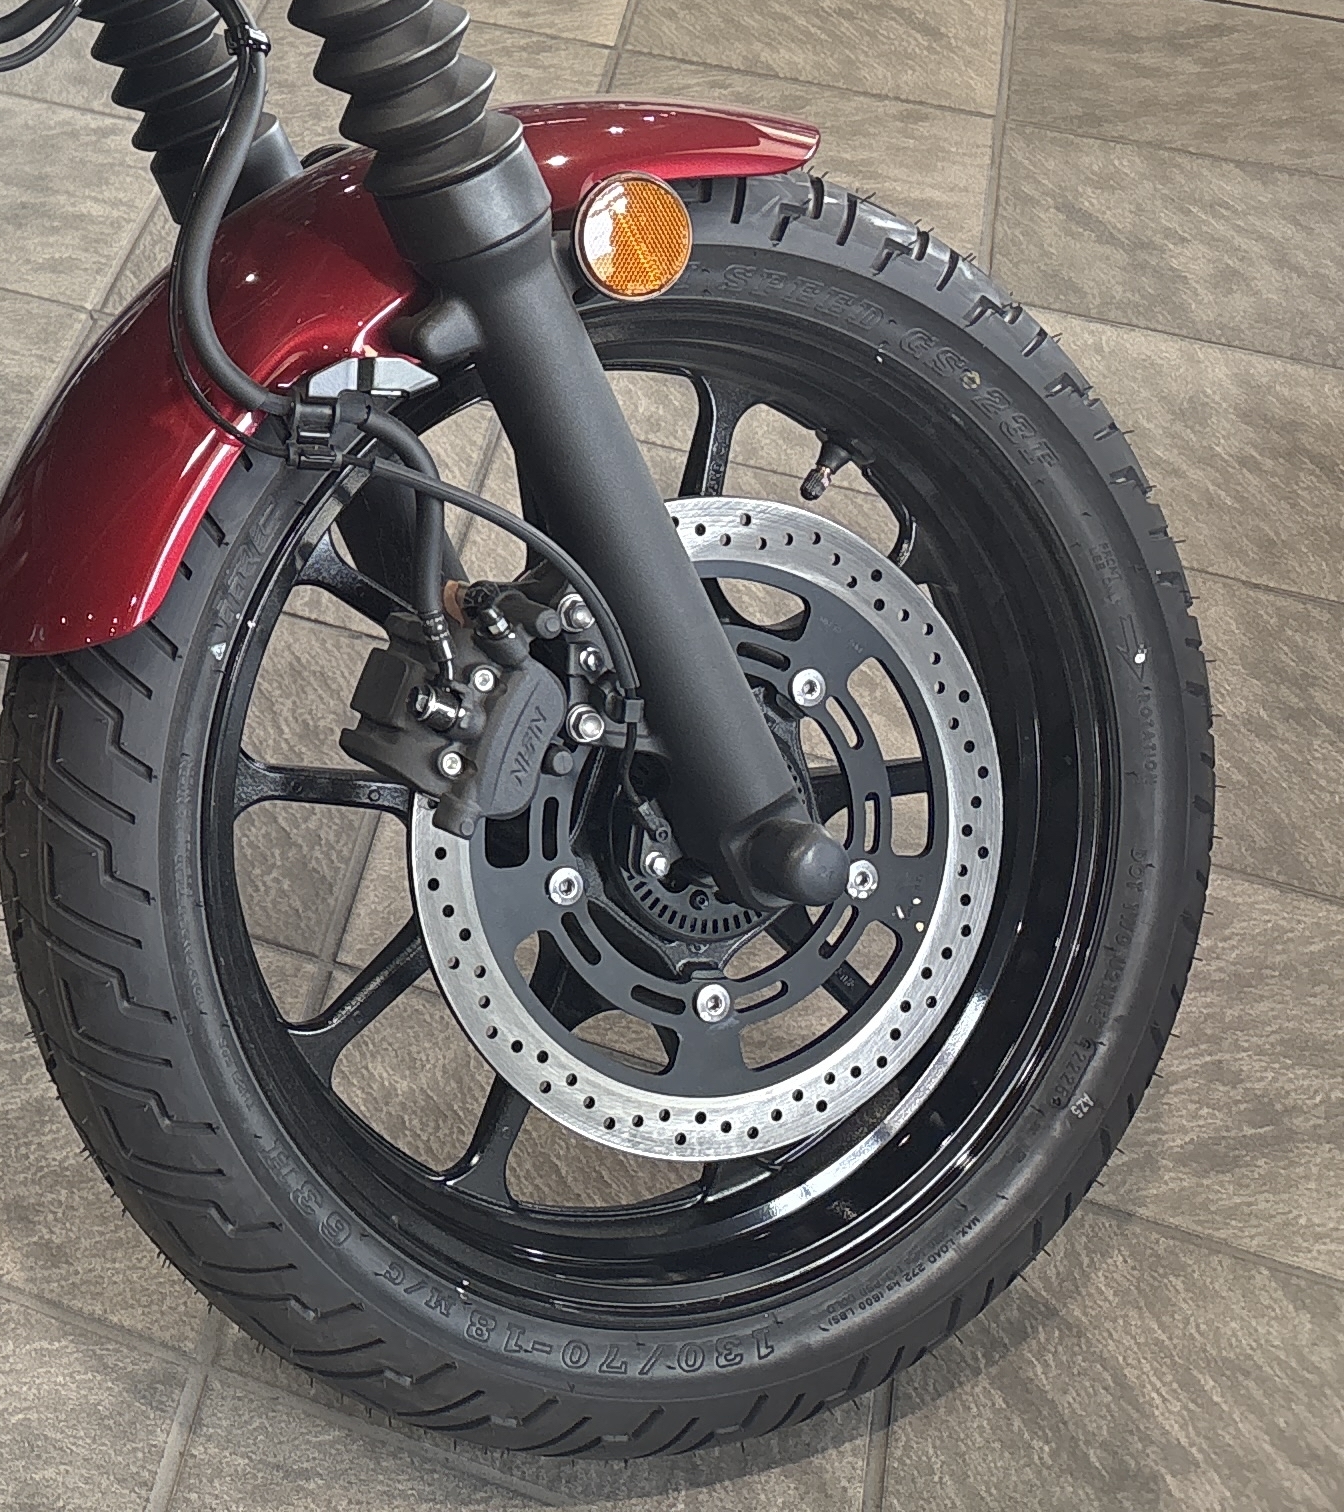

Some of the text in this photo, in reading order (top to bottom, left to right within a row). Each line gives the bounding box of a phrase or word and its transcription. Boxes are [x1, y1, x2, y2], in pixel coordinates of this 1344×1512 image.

[899, 328, 1062, 469] GS23F
[955, 1215, 981, 1238] MAX.
[927, 1237, 956, 1265] LOAD
[902, 1265, 926, 1283] 272
[465, 1309, 776, 1379] 130/70-18
